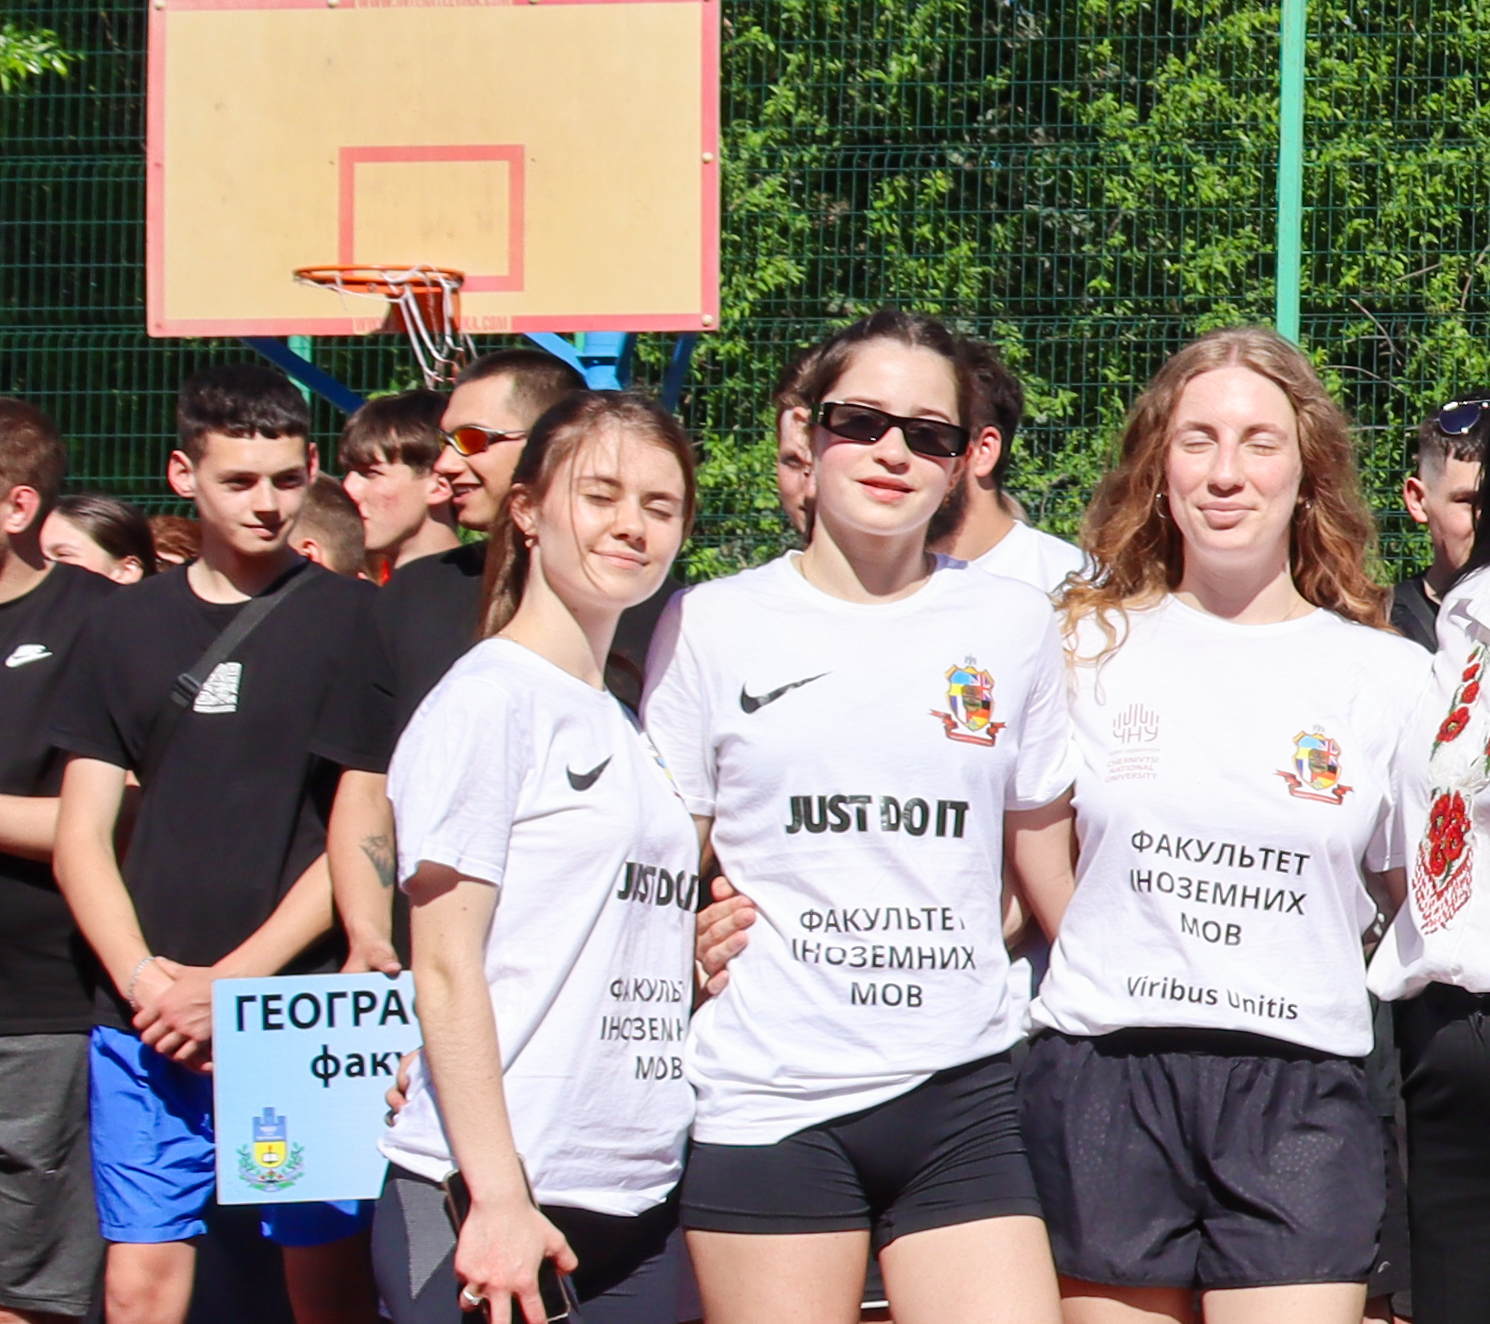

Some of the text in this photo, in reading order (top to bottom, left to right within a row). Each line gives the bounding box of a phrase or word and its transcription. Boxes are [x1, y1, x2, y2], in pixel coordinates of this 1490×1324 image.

[785, 793, 970, 839] JUST DO IT
[1131, 829, 1311, 876] ФАКУЛЬТЕТ
[1129, 868, 1308, 916] ІНОЗЕМНИХ
[799, 907, 965, 933] ФАКУЛЬТЕ
[1180, 911, 1242, 947] МОВ
[791, 937, 977, 971] ІНОЗЕМНИХ
[235, 989, 411, 1032] ГЕОГРА
[851, 981, 923, 1008] МОВ
[1127, 975, 1299, 1021] Viribus Unitis
